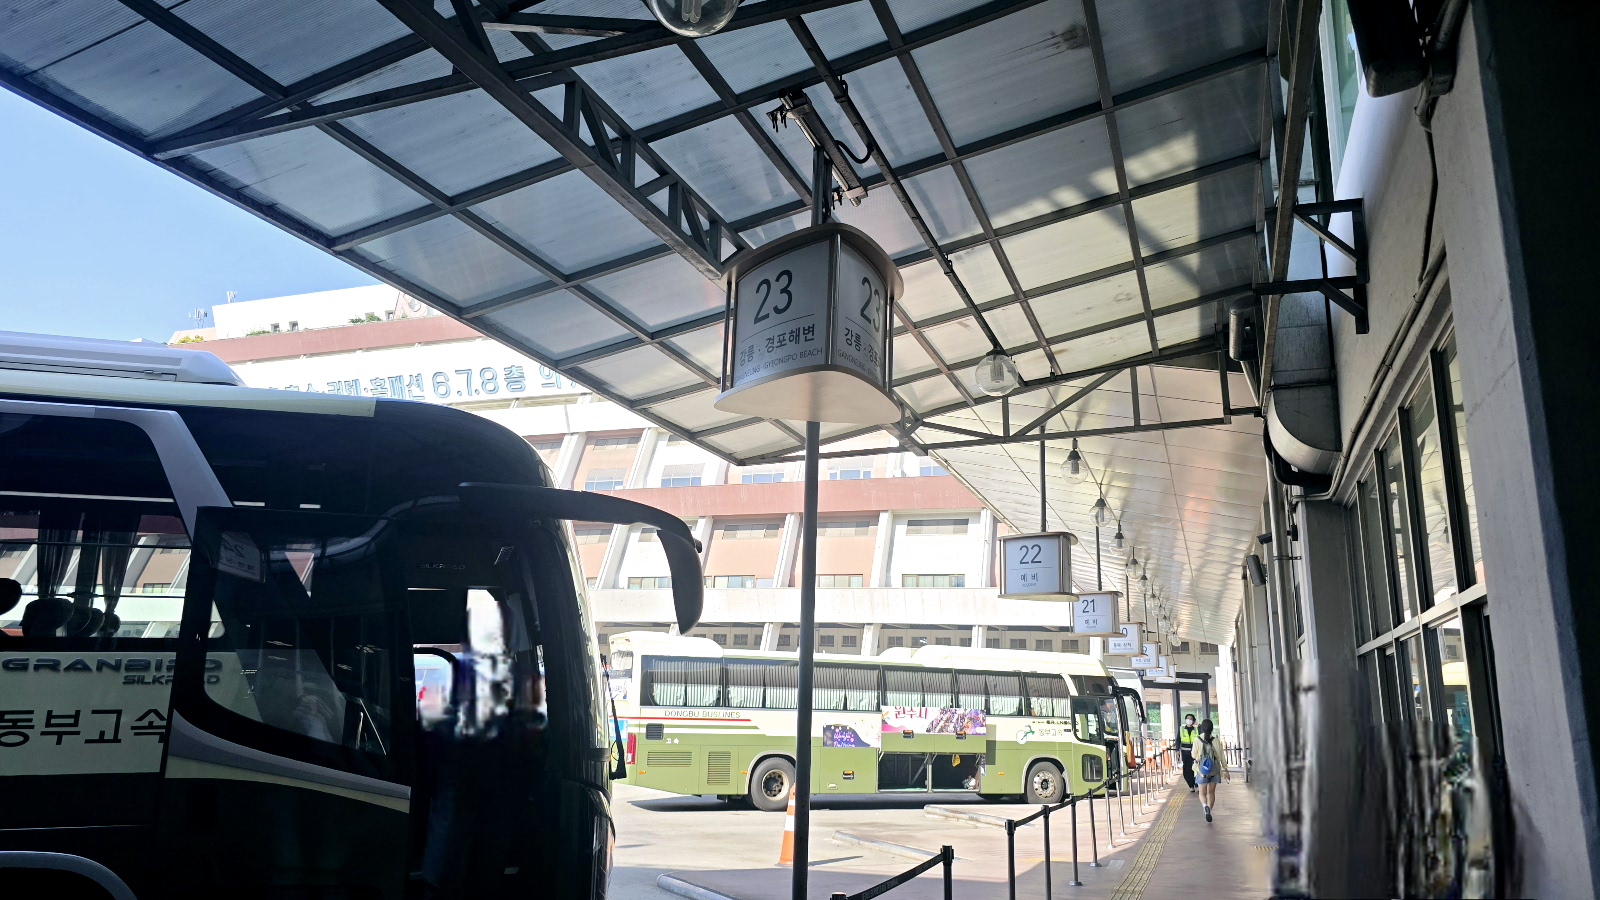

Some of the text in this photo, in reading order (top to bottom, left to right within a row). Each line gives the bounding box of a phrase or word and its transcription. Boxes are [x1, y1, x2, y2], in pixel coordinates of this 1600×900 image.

[754, 269, 793, 325] 23
[861, 277, 880, 333] 23
[739, 324, 815, 366] 강릉 경포해변
[845, 327, 862, 352] 강릉
[800, 347, 823, 359] BEACH
[1019, 544, 1042, 564] 22
[1082, 599, 1096, 613] 21
[122, 674, 220, 685] SILKRD
[0, 708, 167, 747] 동부고속
